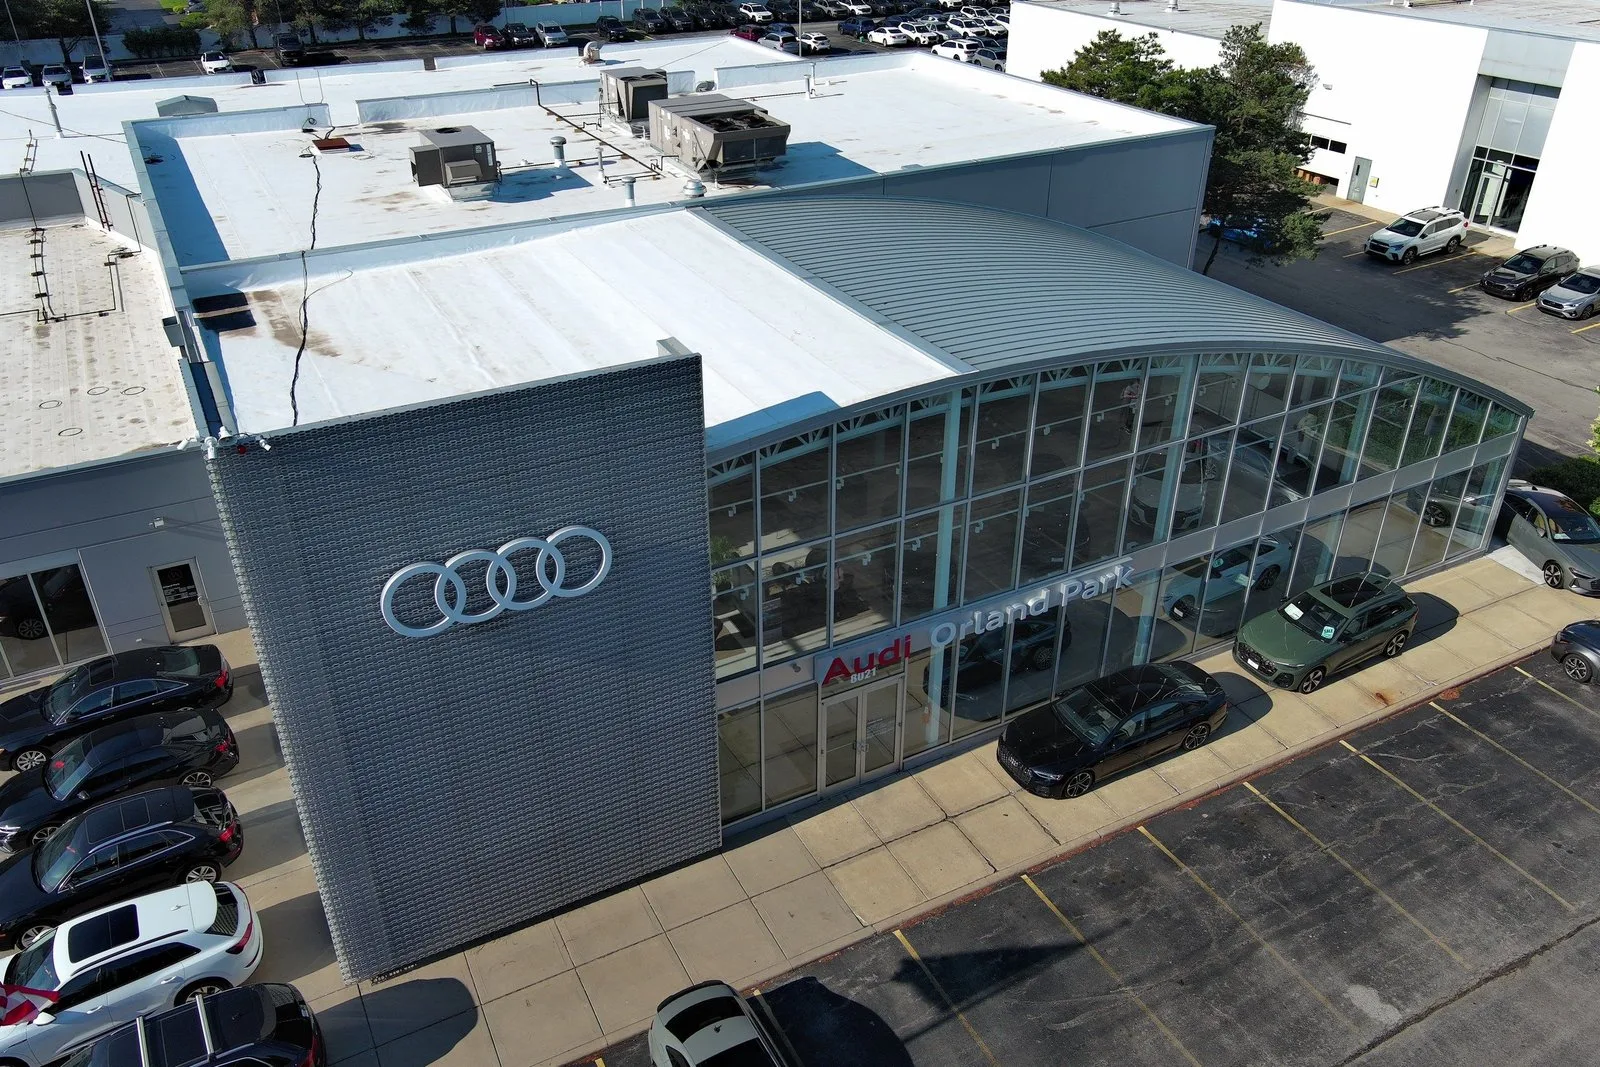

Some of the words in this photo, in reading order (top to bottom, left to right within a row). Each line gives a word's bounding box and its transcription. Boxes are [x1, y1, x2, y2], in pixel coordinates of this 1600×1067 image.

[822, 635, 911, 687] Audi
[930, 588, 1050, 647] Orland
[1061, 564, 1134, 607] Park
